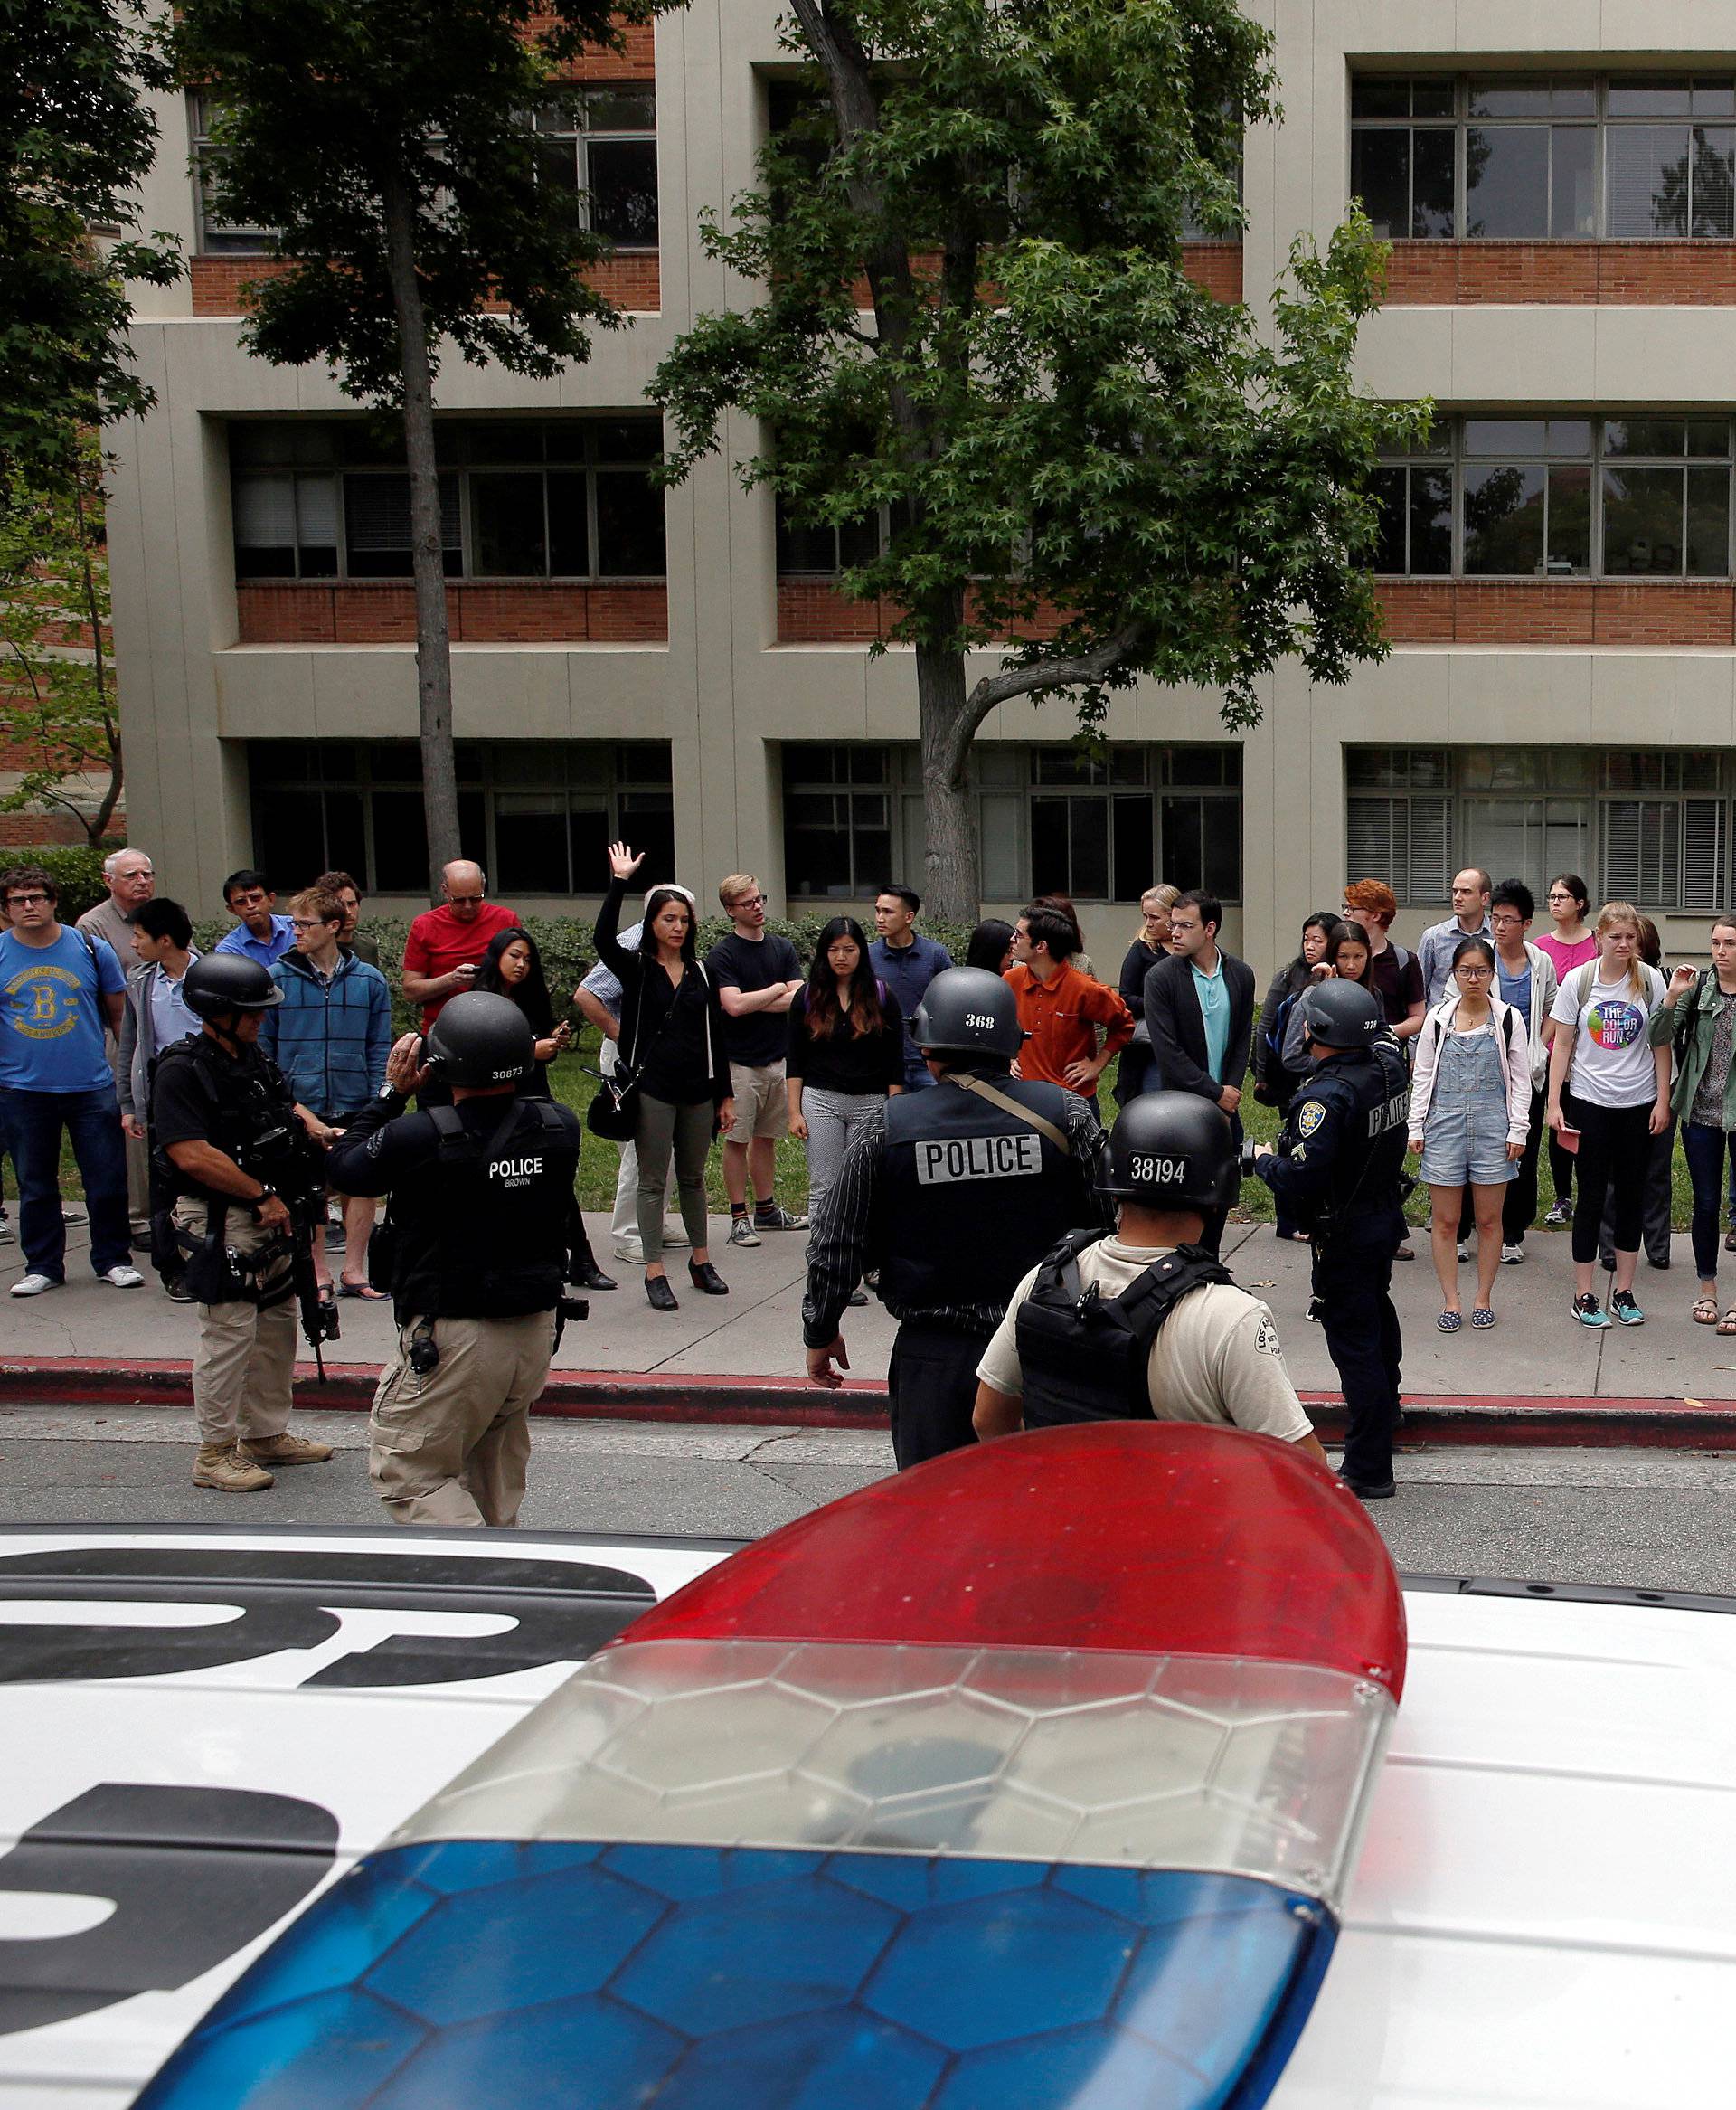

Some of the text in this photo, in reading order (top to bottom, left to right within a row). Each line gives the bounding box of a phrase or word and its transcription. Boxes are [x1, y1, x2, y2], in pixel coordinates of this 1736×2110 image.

[30, 986, 55, 1019] B
[965, 1013, 995, 1030] 368
[1602, 1007, 1623, 1019] THE
[1602, 1018, 1637, 1031] COLOR
[1602, 1031, 1623, 1044] RUN
[492, 1066, 524, 1080] 30873
[926, 1135, 1033, 1180] POLICE
[489, 1157, 543, 1178] POLICE
[1131, 1156, 1184, 1184] 38194
[505, 1178, 531, 1188] BROWN
[1258, 1329, 1266, 1348] LOS
